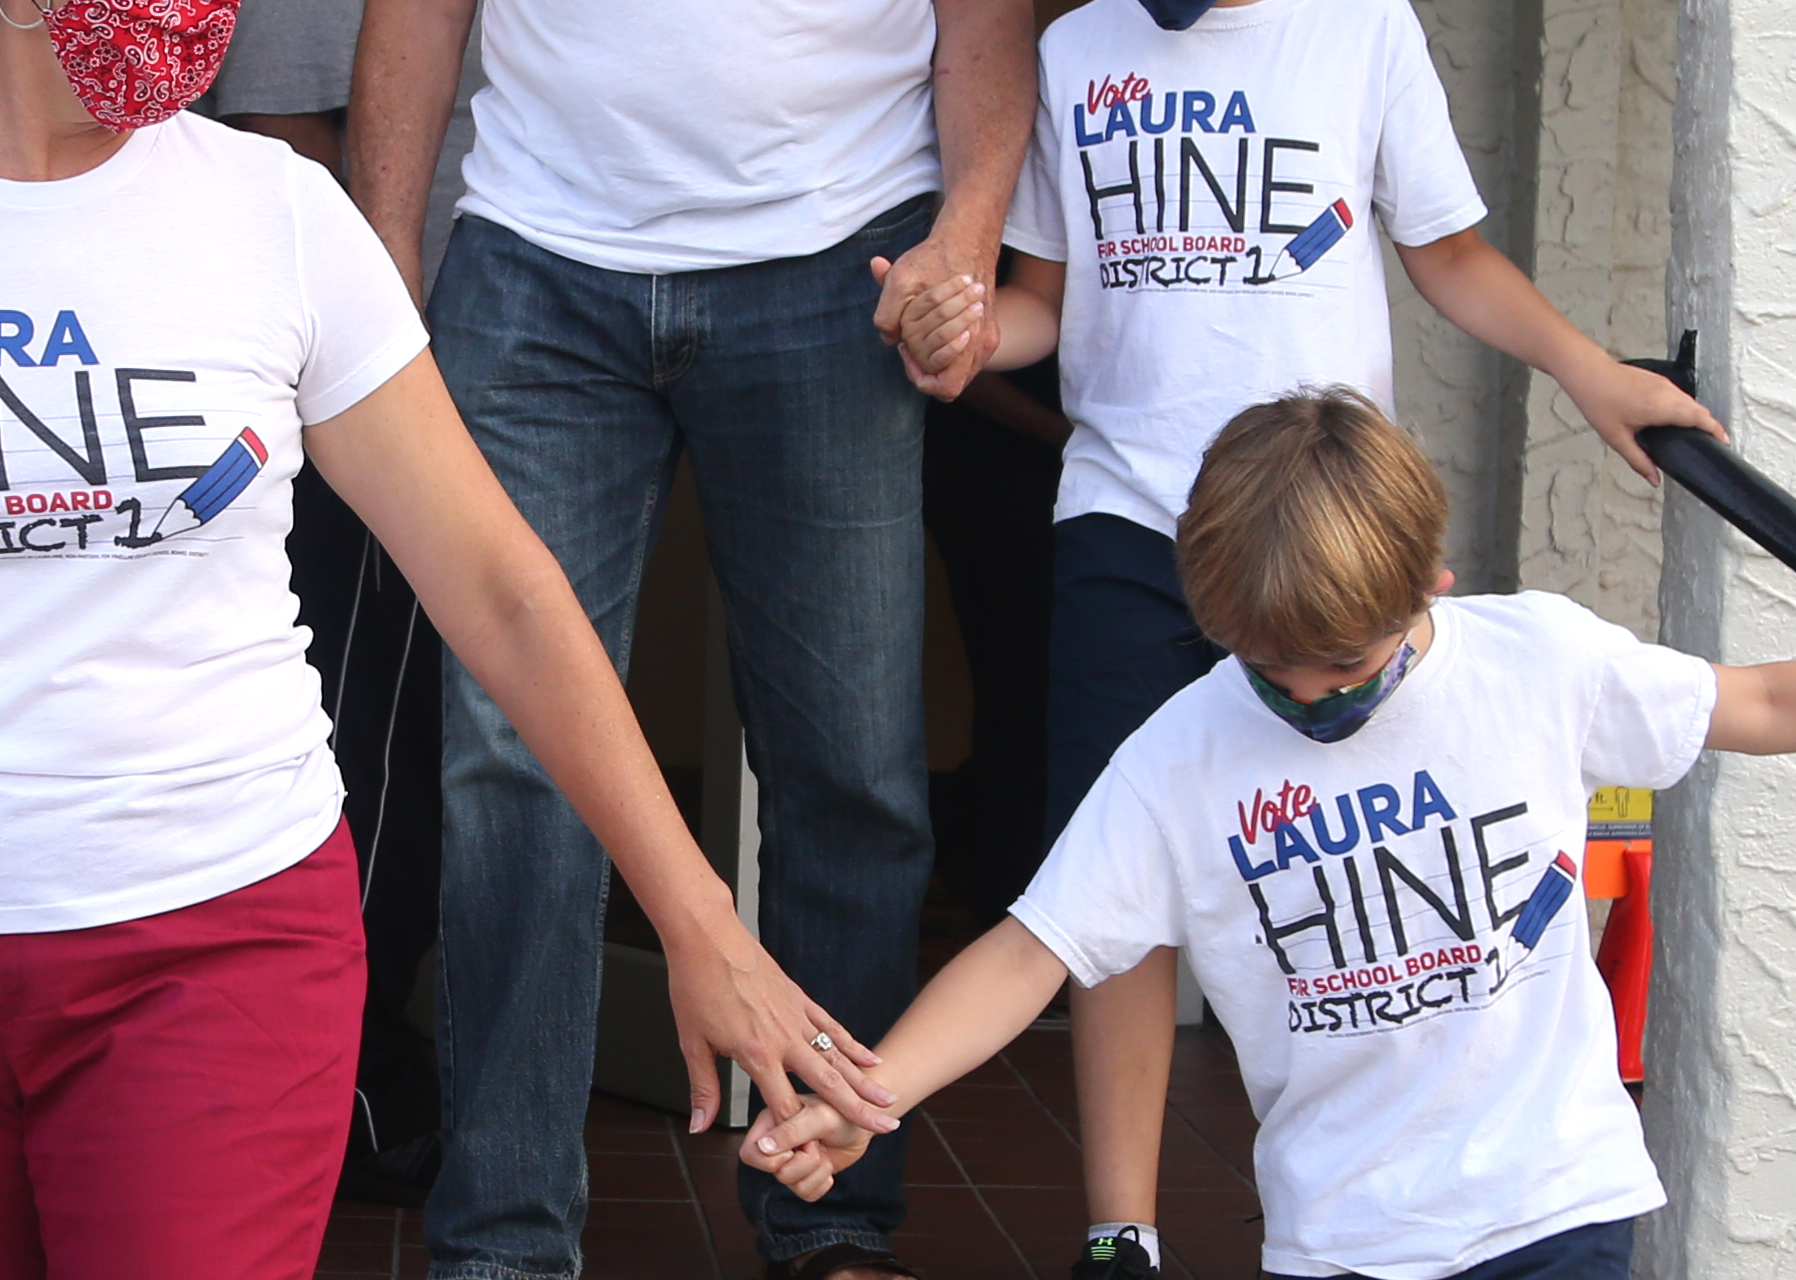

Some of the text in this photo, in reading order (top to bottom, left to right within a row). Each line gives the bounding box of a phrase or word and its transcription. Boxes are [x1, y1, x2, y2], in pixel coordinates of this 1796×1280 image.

[1074, 90, 1256, 148] LAURA
[1087, 71, 1152, 116] Vote
[1080, 137, 1320, 240] HINE
[1100, 245, 1275, 289] DISTRICT 1
[1121, 236, 1179, 255] SCHOOL
[1183, 236, 1245, 253] BOARD
[5, 490, 113, 515] BOARD
[114, 497, 162, 549] 1
[1228, 770, 1458, 882] LAURA
[1238, 778, 1317, 844] Vote
[1248, 802, 1529, 974] HINE
[1313, 964, 1402, 995] SCHOOL
[1405, 945, 1482, 977] BOARD
[1289, 967, 1477, 1033] DISTRICT
